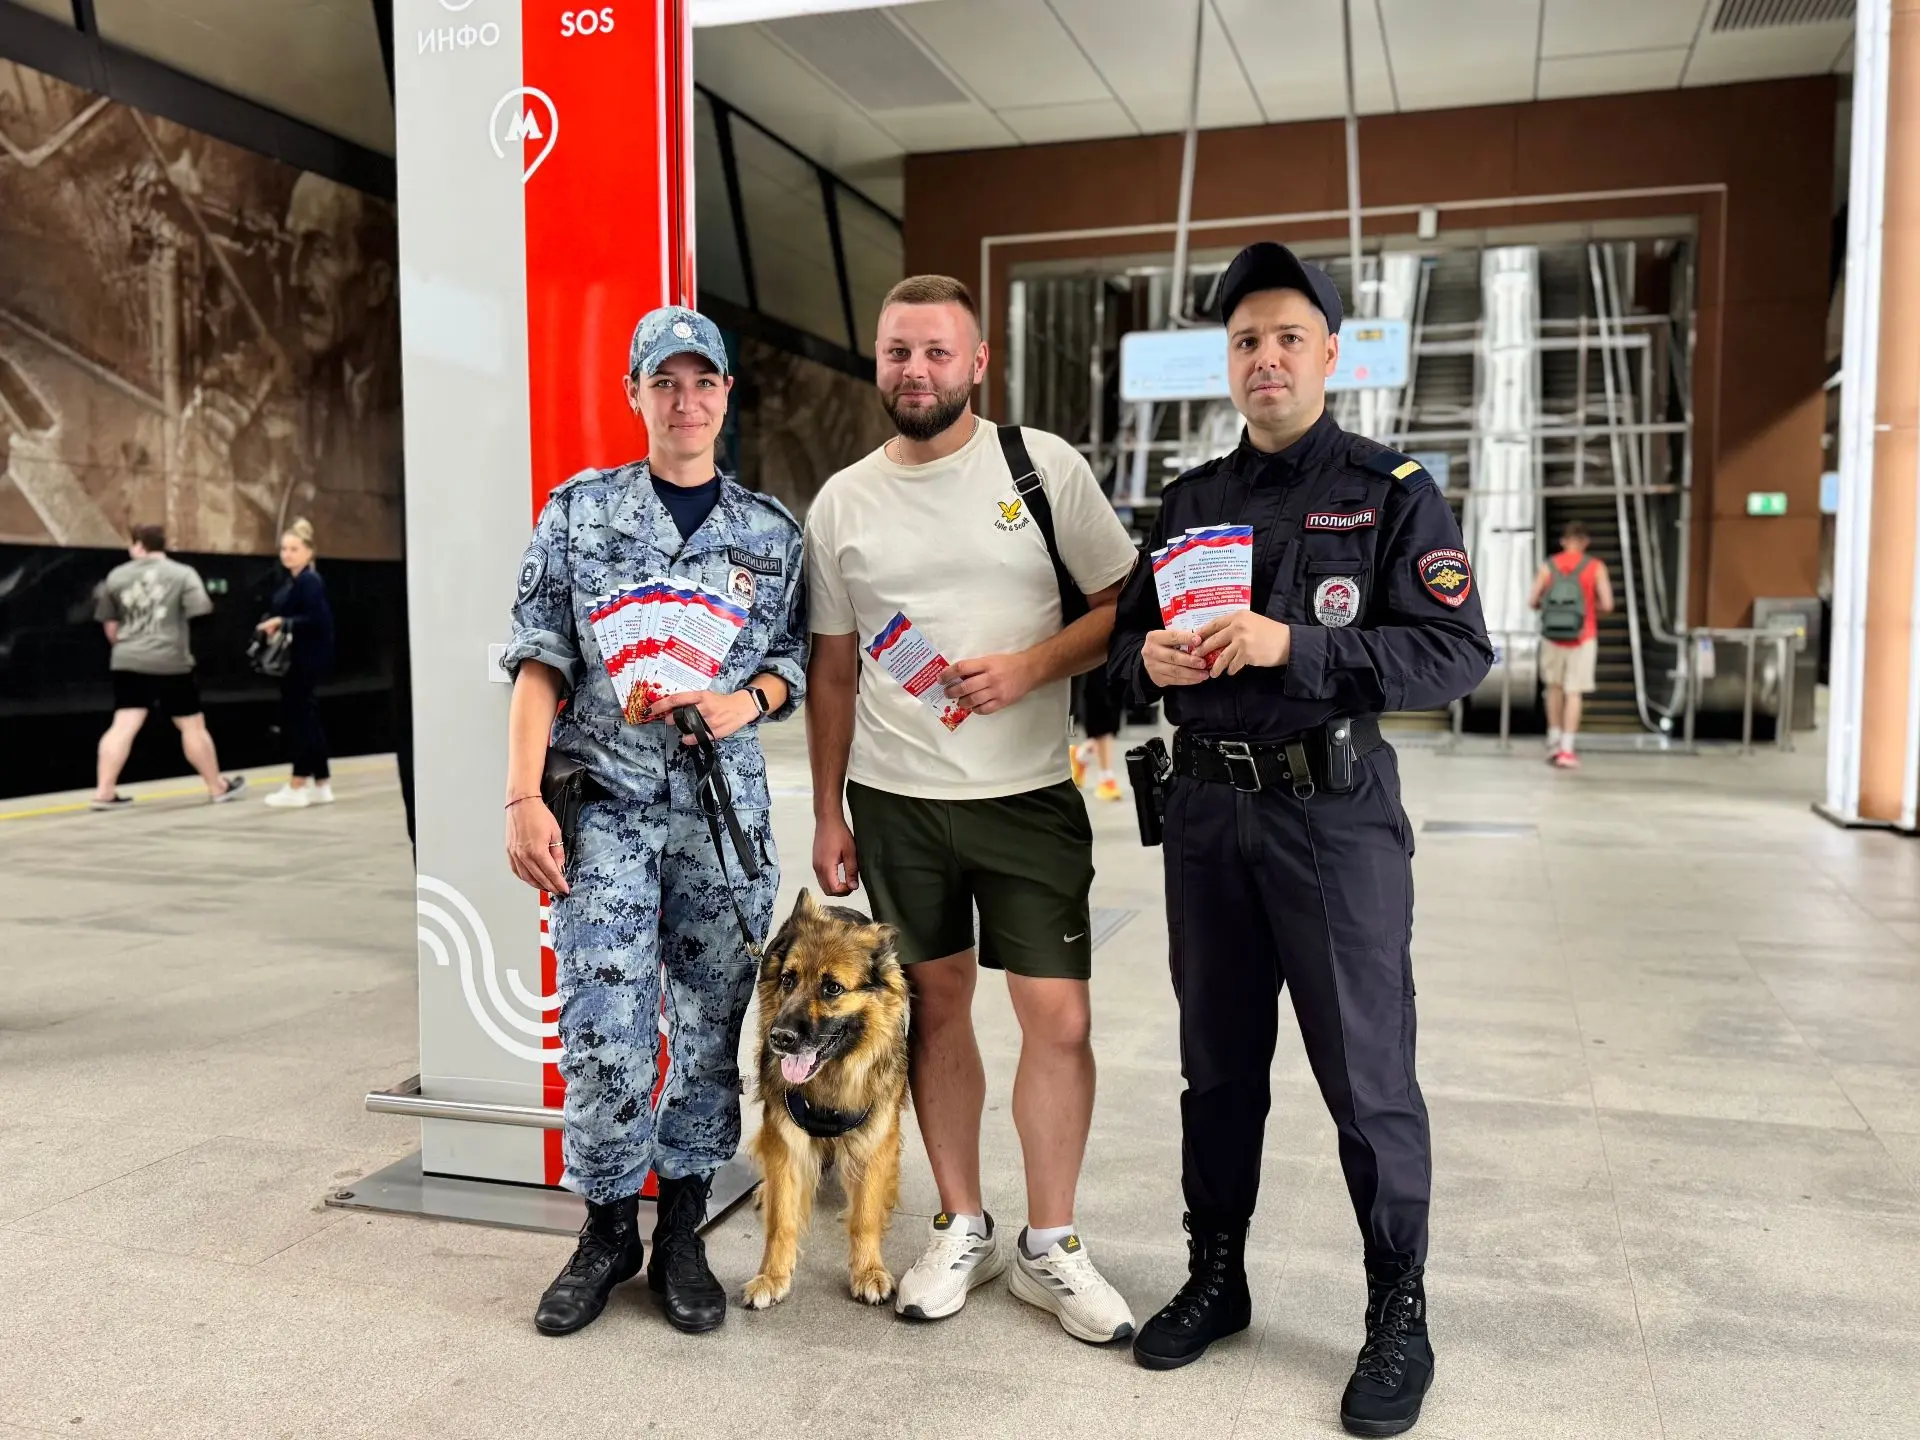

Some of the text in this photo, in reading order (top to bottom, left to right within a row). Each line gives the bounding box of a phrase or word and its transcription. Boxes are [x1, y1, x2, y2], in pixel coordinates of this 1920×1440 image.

[560, 7, 615, 37] SOS
[417, 22, 500, 55] ИНФО
[994, 519, 1008, 532] Lyle
[1013, 517, 1030, 531] Scott
[1309, 511, 1373, 527] ПОЛИЦИЯ
[733, 549, 779, 571] ПОЛИЦИЯ
[1420, 550, 1464, 568] ПОЛИЦИЯ
[1428, 559, 1462, 574] РОССИЯ
[1445, 594, 1465, 606] МВД
